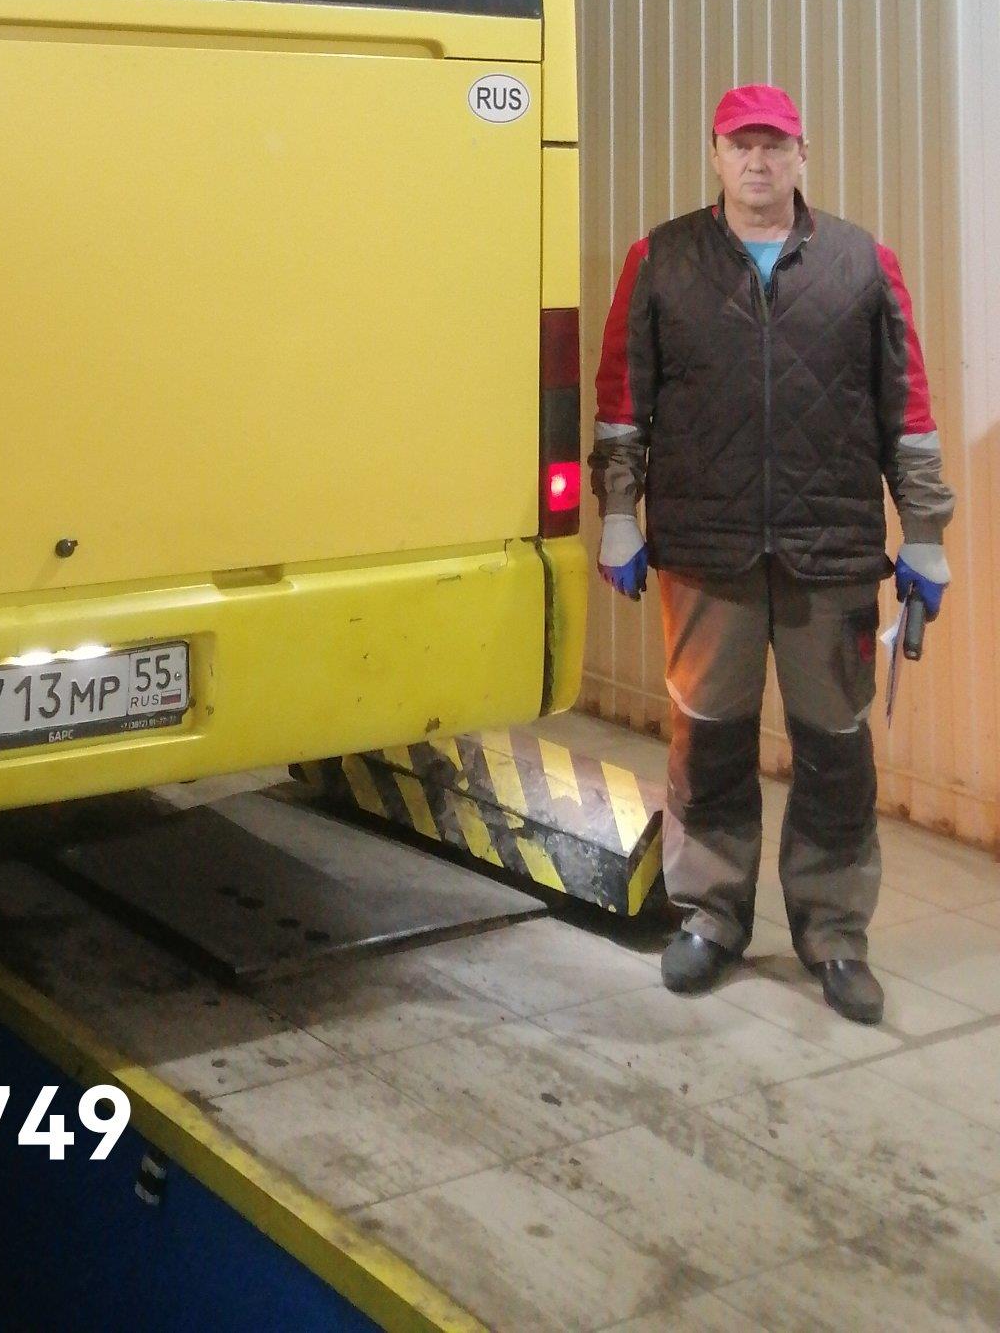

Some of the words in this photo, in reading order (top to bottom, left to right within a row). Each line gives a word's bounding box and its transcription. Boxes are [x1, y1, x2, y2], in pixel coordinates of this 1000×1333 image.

[476, 86, 522, 111] RUS
[135, 654, 171, 692] 55
[130, 695, 159, 708] RUS
